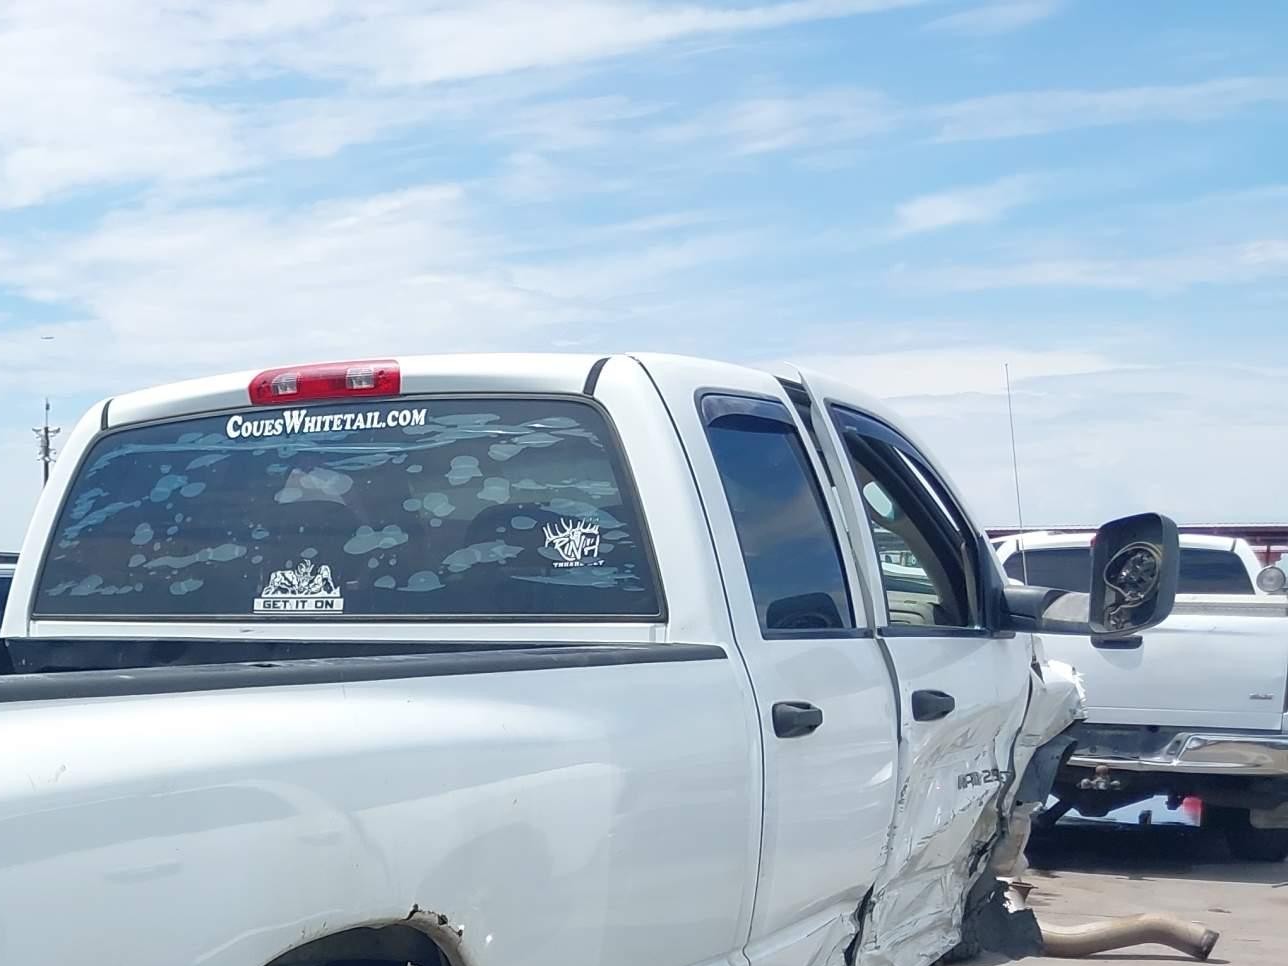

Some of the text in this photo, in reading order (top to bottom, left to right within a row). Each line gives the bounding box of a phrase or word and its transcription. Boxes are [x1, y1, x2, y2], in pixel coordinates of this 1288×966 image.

[262, 599, 335, 609] GET IT ON
